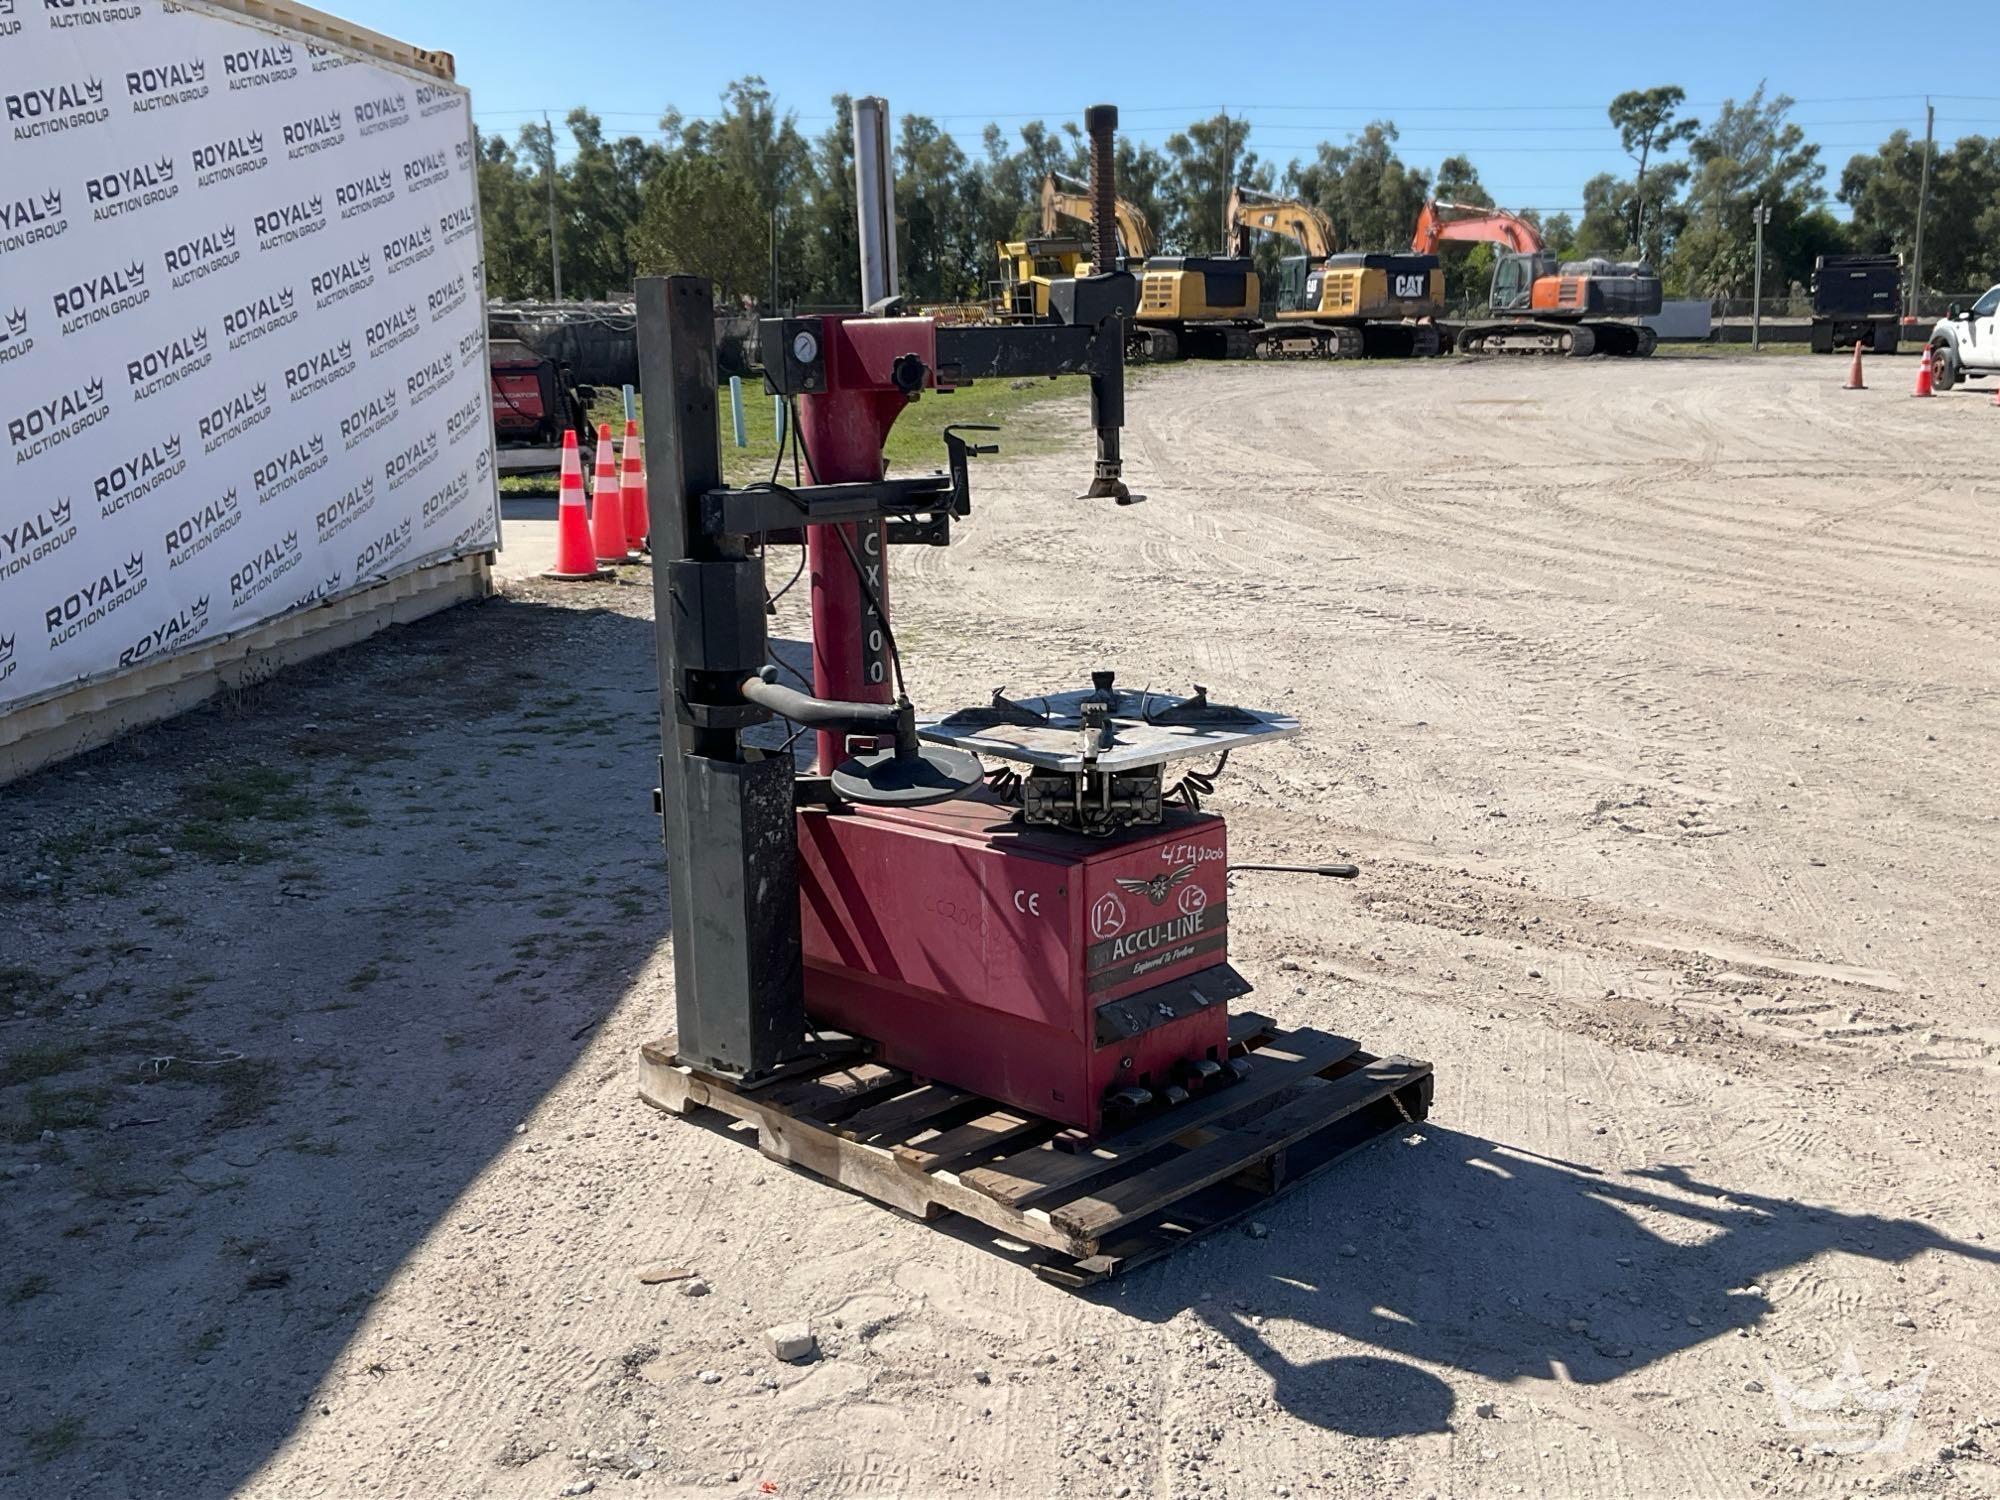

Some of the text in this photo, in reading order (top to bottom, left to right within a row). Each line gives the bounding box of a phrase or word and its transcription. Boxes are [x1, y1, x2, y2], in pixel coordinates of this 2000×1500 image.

[50, 6, 141, 28] AUCTION GROUP
[128, 64, 192, 95] ROYAL
[224, 48, 282, 75] ROYAL
[230, 68, 297, 90] AUCTION GROUP
[312, 60, 344, 72] AUCTION
[5, 84, 86, 120] ROYAL
[134, 86, 208, 113] AUCTION GROUP
[354, 98, 398, 123] ROYAL
[15, 108, 110, 140] AUCTION GROUP
[283, 116, 330, 145] ROYAL
[360, 121, 388, 136] AUCTION
[192, 138, 249, 171] ROYAL
[289, 142, 320, 160] AUCTION
[404, 156, 439, 180] ROYAL
[86, 165, 158, 203] ROYAL
[198, 157, 267, 188] AUCTION GROUP
[95, 185, 178, 221] AUCTION GROUP
[336, 176, 381, 206] ROYAL
[0, 198, 45, 230] YAL
[254, 202, 311, 236] ROYAL
[342, 201, 371, 219] AUCTION
[440, 208, 471, 234] ROYAL
[26, 220, 67, 244] GROUP
[260, 218, 326, 251] AUCTION GROUP
[383, 232, 423, 262] ROYAL
[164, 234, 222, 272] ROYAL
[172, 251, 240, 289] AUCTION GROUP
[54, 272, 128, 318] ROYAL
[311, 261, 360, 296] ROYAL
[428, 283, 457, 310] ROYAL
[1396, 275, 1424, 297] CAT
[63, 289, 150, 336] AUCTION GROUP
[224, 296, 280, 336] ROYAL
[317, 287, 348, 310] AUCTION
[230, 311, 298, 351] AUCTION GROUP
[366, 312, 407, 346] ROYAL
[0, 338, 34, 364] ROUP
[128, 338, 194, 384] ROYAL
[370, 337, 398, 359] AUCTION
[136, 353, 212, 400] AUCTION GROUP
[285, 349, 340, 389] ROYAL
[291, 361, 356, 403] AUCTION GROUP
[407, 360, 444, 394] ROYAL
[8, 390, 88, 446] ROYAL
[199, 393, 254, 439] ROYAL
[205, 406, 271, 455] AUCTION GROUP
[340, 398, 386, 438] ROYAL
[447, 400, 475, 434] ROYAL
[18, 405, 110, 464] AUCTION GROUP
[346, 425, 374, 451] AUCTION
[94, 447, 165, 502] ROYAL
[254, 445, 311, 490] ROYAL
[386, 440, 428, 479] ROYAL
[102, 460, 186, 519] AUCTION GROUP
[260, 455, 328, 504] AUCTION GROUP
[390, 466, 417, 491] AUCTION
[316, 487, 363, 532] ROYAL
[423, 480, 459, 518] ROYAL
[0, 514, 52, 555] YAL
[166, 500, 225, 554] ROYAL
[173, 510, 241, 566] AUCTION GROUP
[320, 516, 351, 543] AUCTION
[0, 526, 77, 581] TION GROUP
[357, 528, 400, 572] ROYAL
[230, 544, 285, 596] ROYAL
[235, 552, 302, 607] AUCTION GROUP
[46, 569, 126, 633] ROYAL
[51, 578, 147, 650] AUCTION GROUP
[119, 610, 190, 668] ROYAL
[1014, 889, 1040, 916] CE
[1112, 911, 1205, 961] ACCU-LINE
